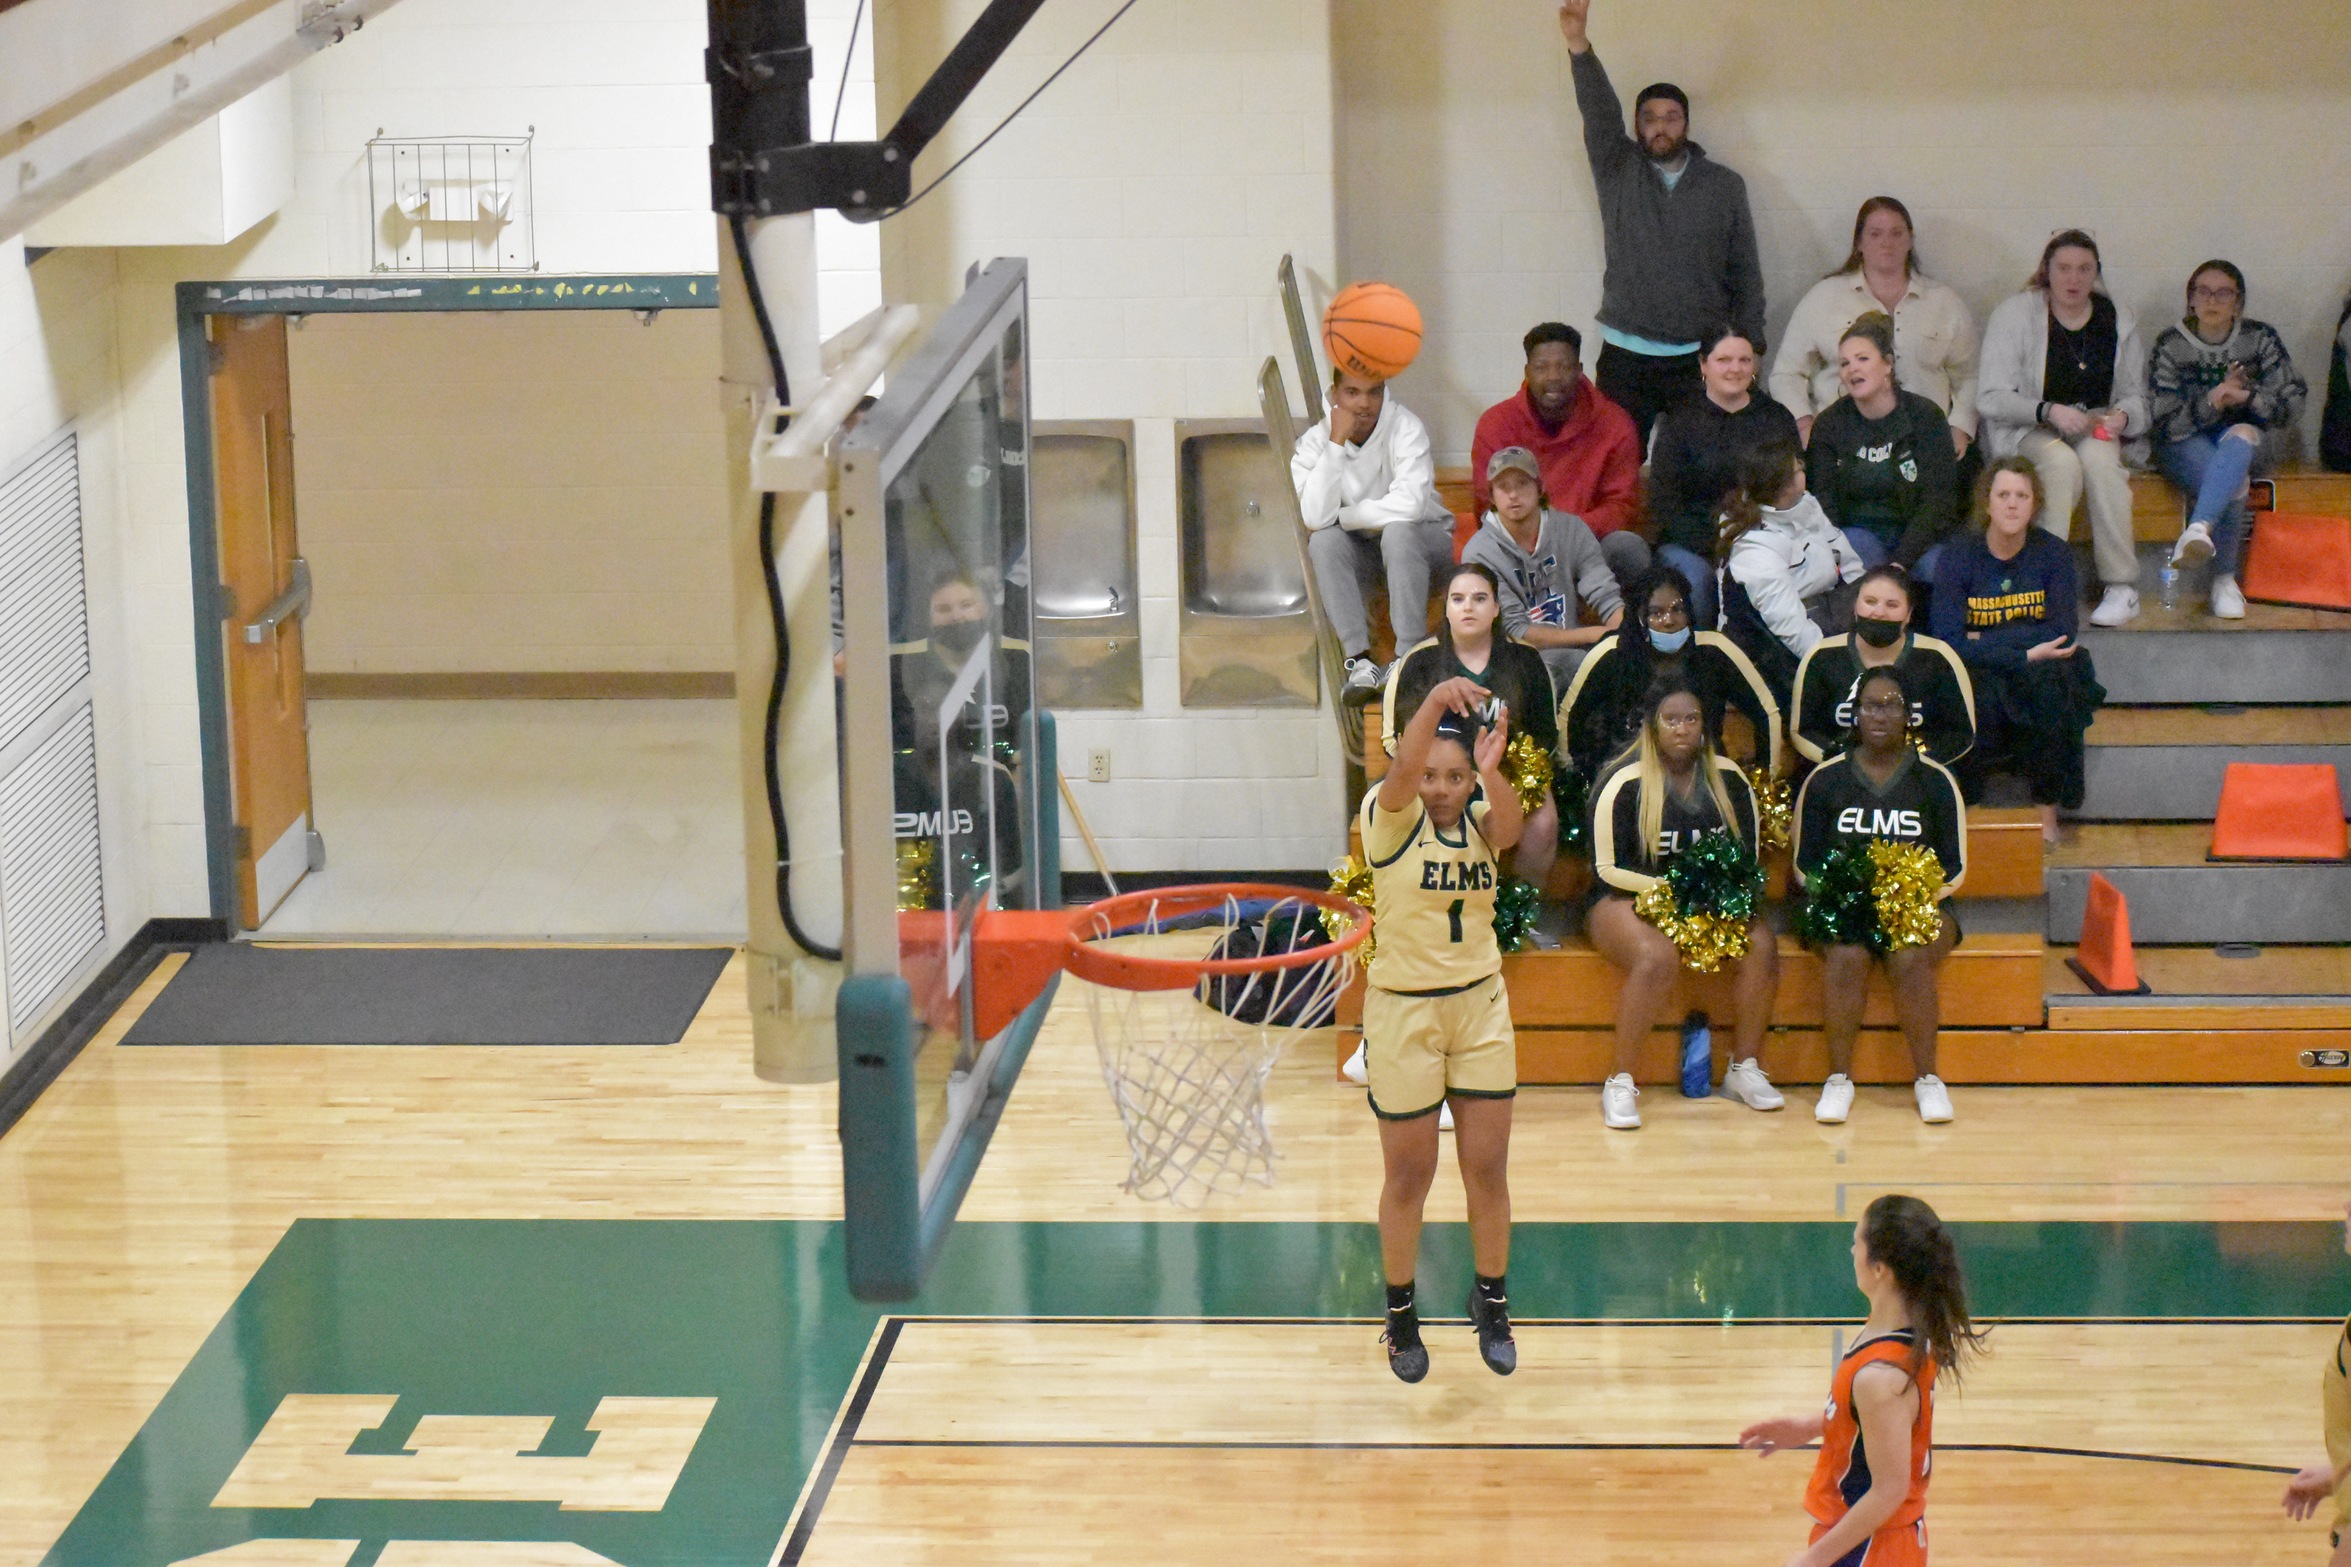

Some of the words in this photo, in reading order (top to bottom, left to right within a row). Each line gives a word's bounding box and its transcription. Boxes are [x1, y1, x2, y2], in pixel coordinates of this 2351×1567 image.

[1835, 702, 1924, 728] ES
[1837, 807, 1922, 837] ELMS
[1420, 860, 1492, 891] ELMS
[1447, 899, 1465, 943] 1
